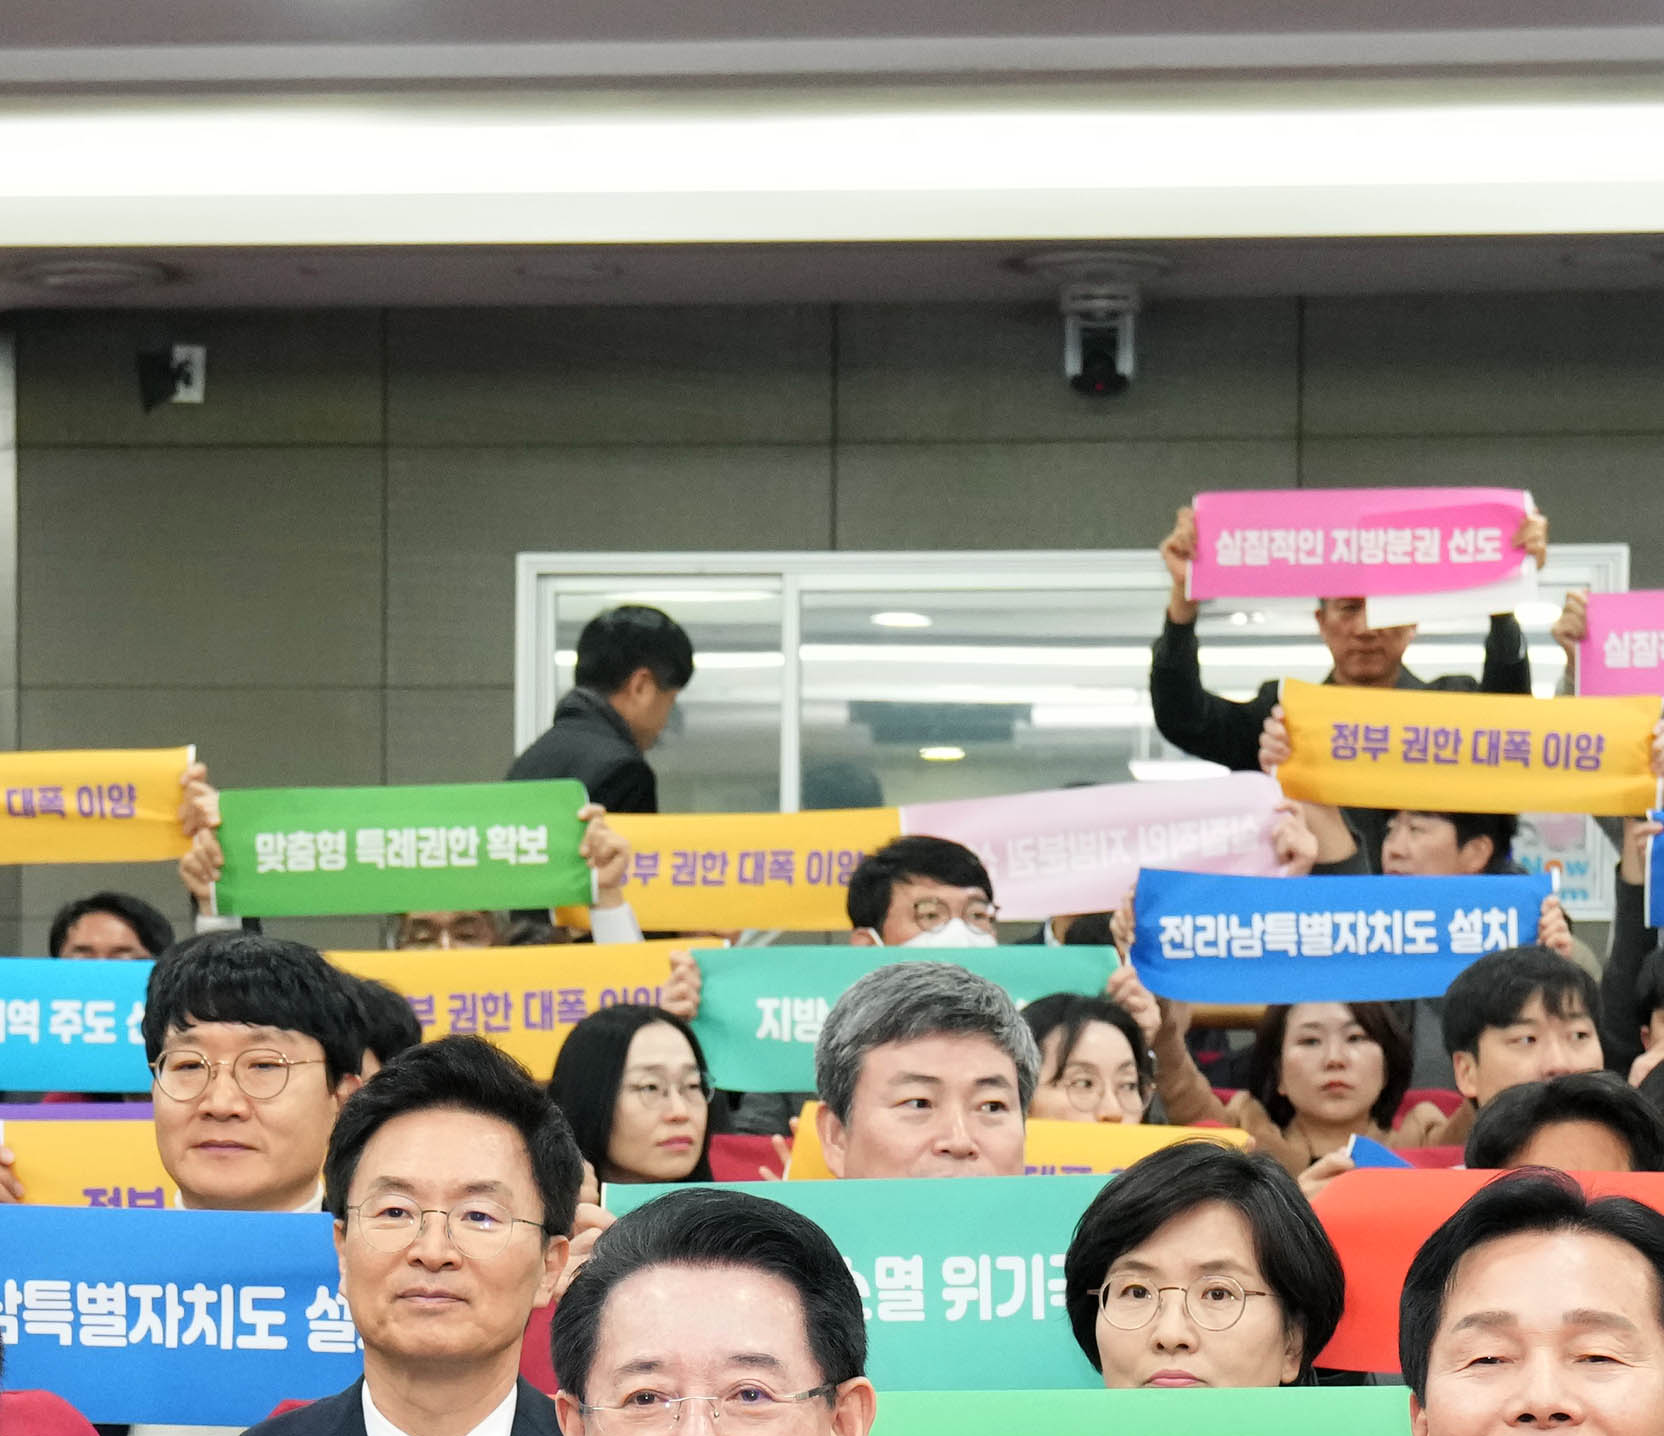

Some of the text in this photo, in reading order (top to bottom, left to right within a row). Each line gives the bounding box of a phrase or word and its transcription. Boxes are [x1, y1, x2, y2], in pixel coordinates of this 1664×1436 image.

[1215, 525, 1502, 566] 실질적인 지방분권 선도
[1331, 723, 1604, 770] 정부 권한 대폭 이양
[6, 786, 66, 819] 대폭
[77, 783, 138, 819] 이양
[256, 824, 549, 875] 맞춤형 특례권한 확보
[620, 851, 659, 886] 부
[672, 850, 730, 887] 권한
[738, 850, 796, 886] 대폭
[1158, 905, 1518, 960] 전라남특별자치도 설치
[49, 1000, 118, 1044] 주도
[448, 992, 513, 1032] 권한
[523, 989, 588, 1030] 대폭
[306, 1285, 363, 1353] 설
